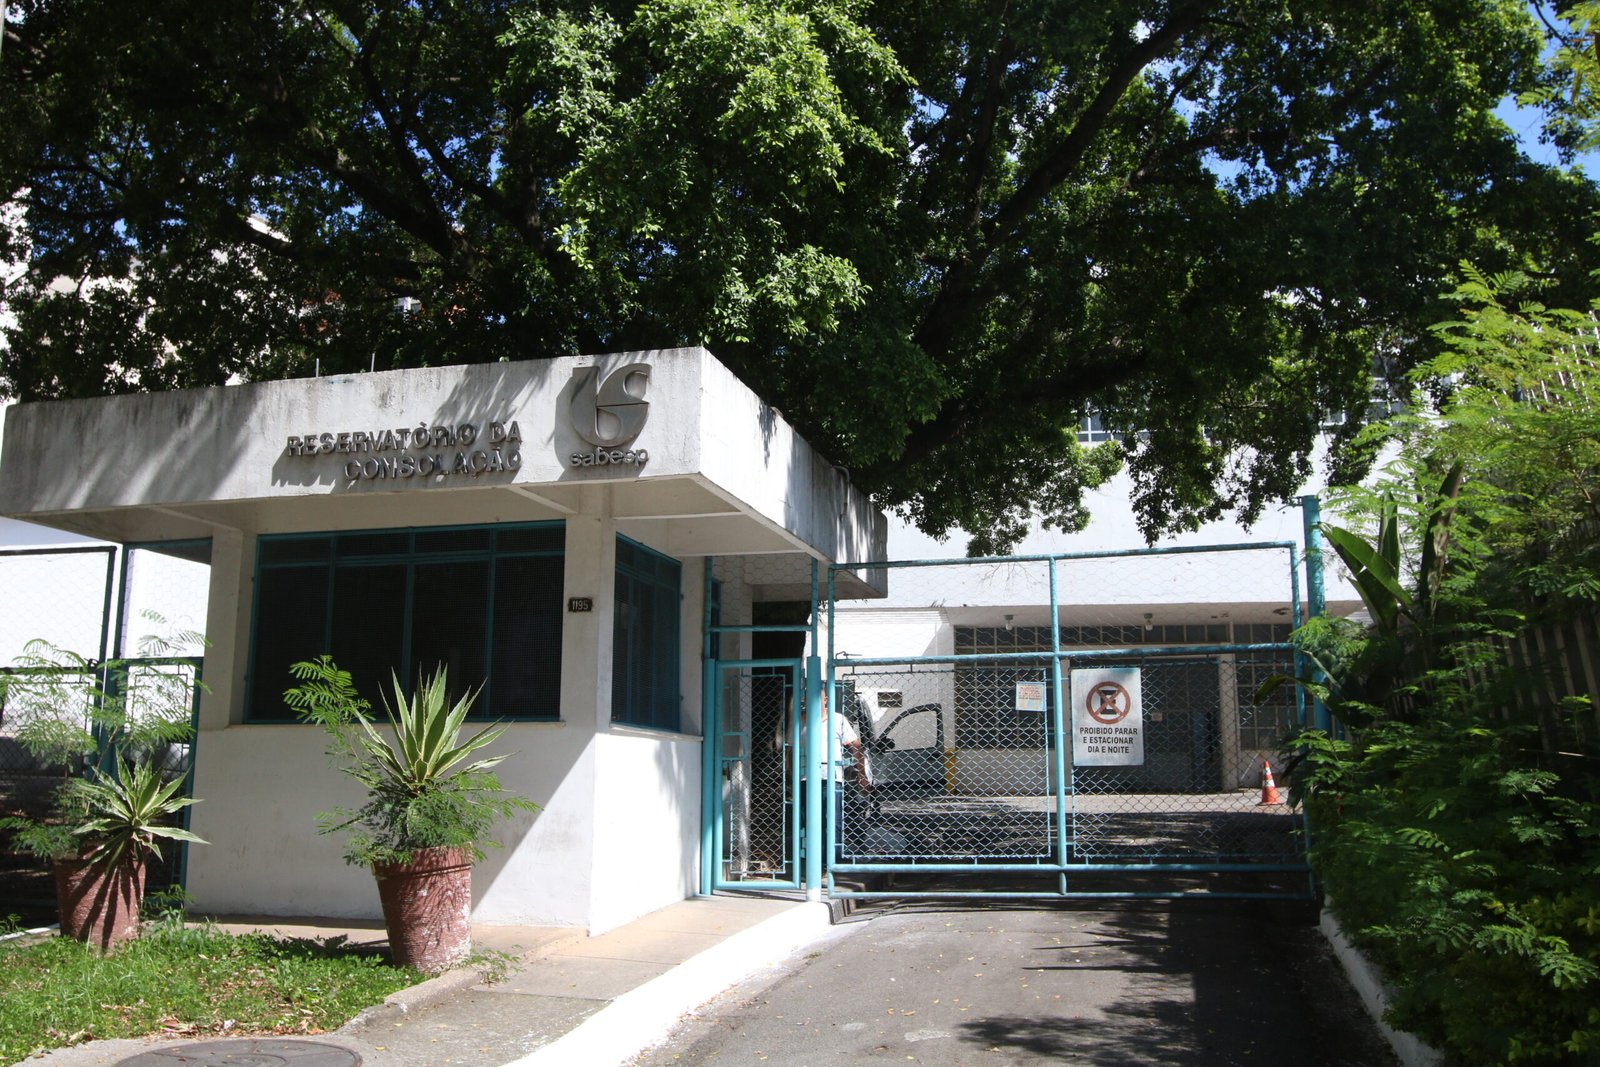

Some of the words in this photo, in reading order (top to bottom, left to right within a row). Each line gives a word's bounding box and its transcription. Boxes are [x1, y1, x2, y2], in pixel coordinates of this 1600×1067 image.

[488, 420, 523, 445] DA
[570, 446, 649, 468] sabesp
[344, 446, 523, 481] CONSOLAÇÃO
[572, 600, 589, 611] 1195
[1079, 727, 1113, 735] PROIBIDO
[1114, 727, 1138, 735] PARAR
[1089, 736, 1134, 744] ESTACIONAR
[1087, 745, 1100, 753] DIA
[1101, 745, 1106, 753] E
[1107, 745, 1129, 753] NOITE
